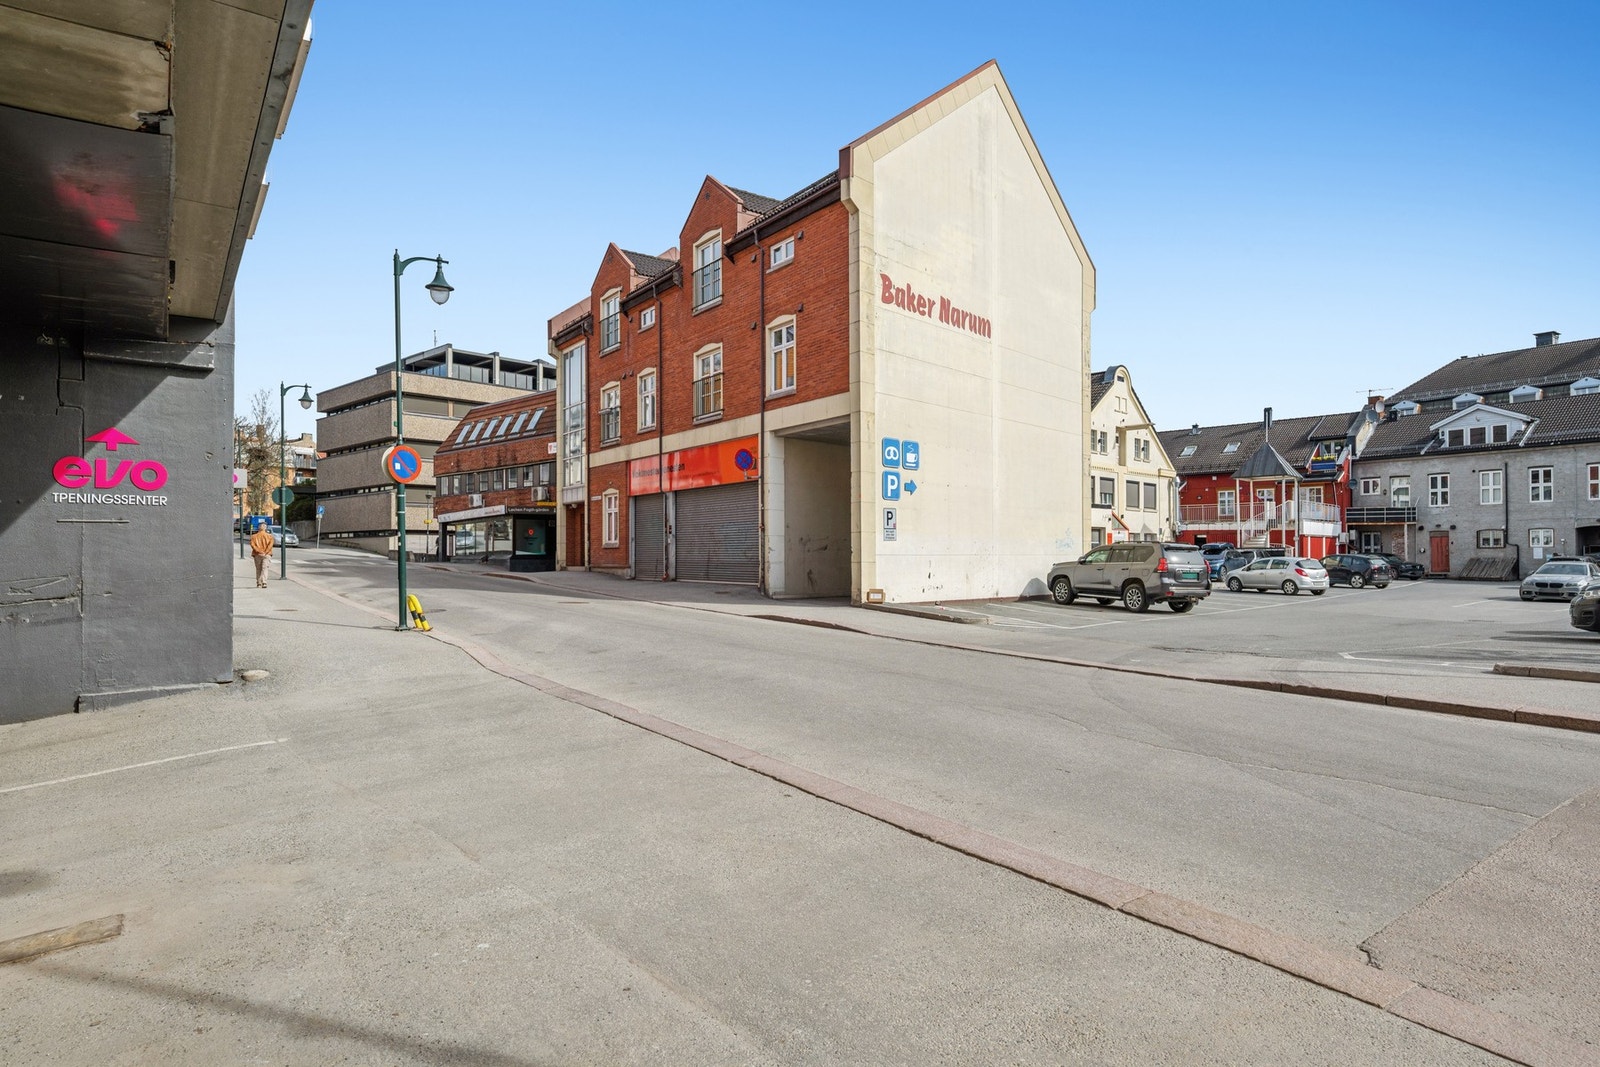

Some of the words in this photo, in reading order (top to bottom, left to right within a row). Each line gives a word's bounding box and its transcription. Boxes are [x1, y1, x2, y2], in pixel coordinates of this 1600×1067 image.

[880, 273, 936, 318] Baker
[939, 296, 991, 339] Narum
[53, 456, 168, 491] evo
[887, 475, 898, 496] P
[887, 511, 893, 526] P
